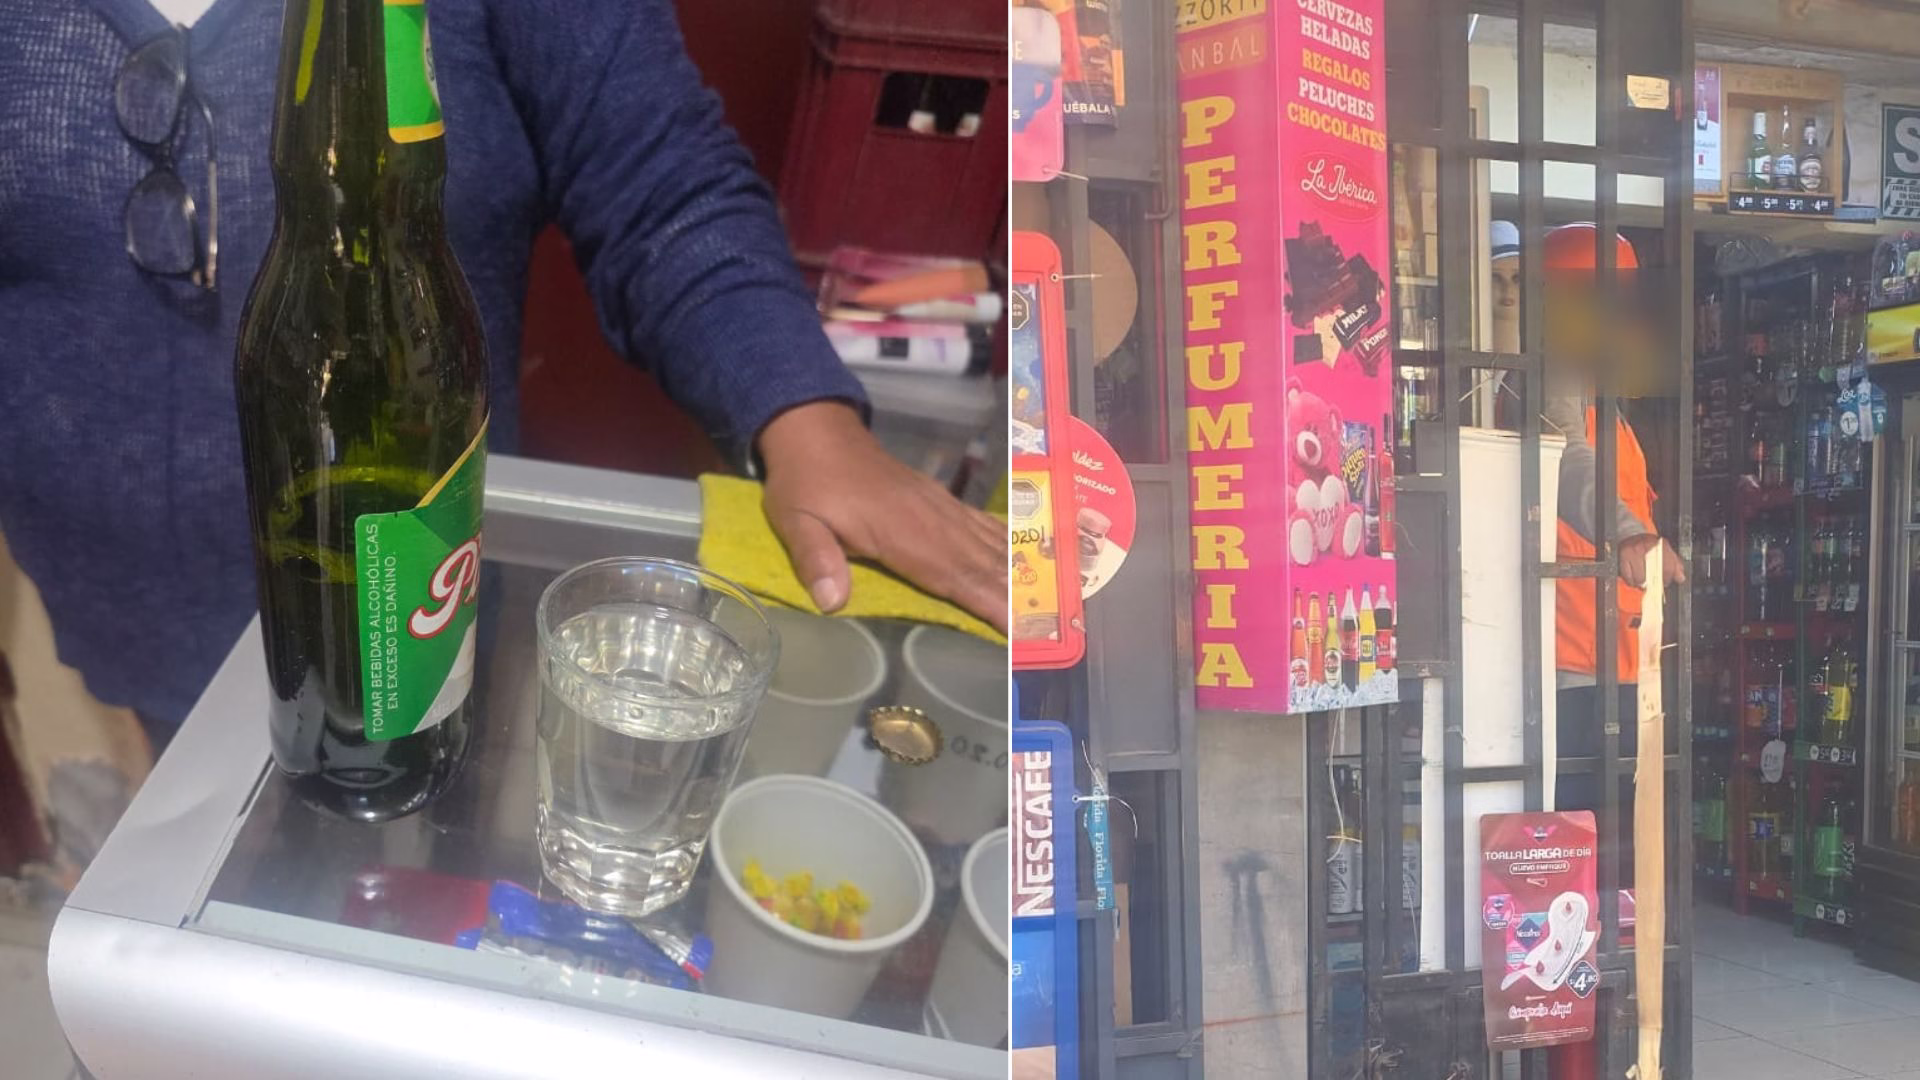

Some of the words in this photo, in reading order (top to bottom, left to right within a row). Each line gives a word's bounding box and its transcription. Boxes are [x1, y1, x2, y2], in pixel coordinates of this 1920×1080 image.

[1297, 0, 1373, 36] CERVEZAS
[1301, 15, 1370, 60] HELADAS
[1302, 47, 1370, 91] REGALOS
[1298, 76, 1374, 122] PELUCHES
[1288, 101, 1386, 152] CHOCOLATES
[1301, 159, 1338, 200] La
[1329, 164, 1377, 204] Ibérica
[1181, 96, 1255, 688] PERFUMERIA
[1073, 474, 1117, 496] ORIZADO
[366, 523, 382, 628] ALCOHÓLICAS
[382, 551, 397, 612] DAÑINO.
[385, 615, 398, 633] ES
[370, 631, 383, 689] BEBIDAS
[386, 637, 398, 689] EXCESO
[372, 691, 384, 735] TOMAR
[387, 692, 399, 710] EN
[1095, 832, 1108, 878] Florida
[1485, 851, 1522, 861] TOALLA
[1523, 847, 1562, 860] LARGA
[1563, 848, 1576, 858] DE
